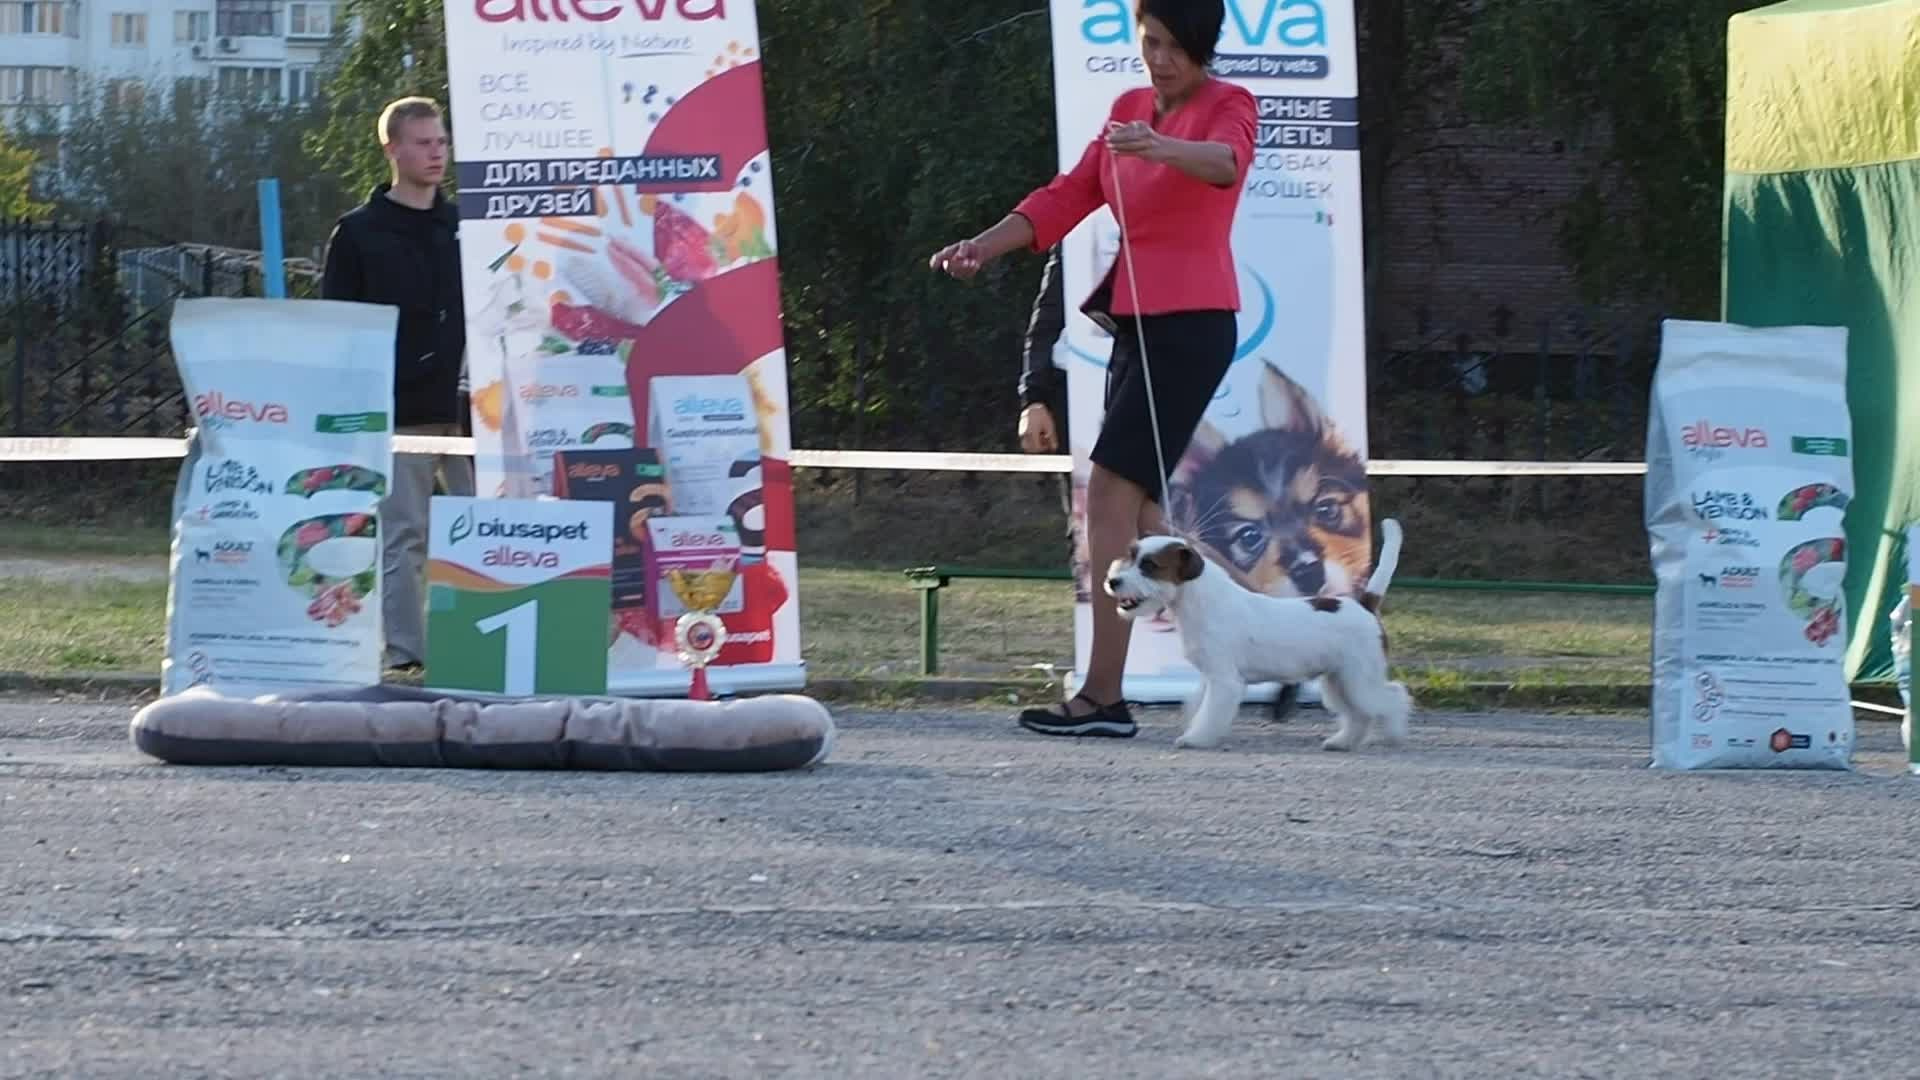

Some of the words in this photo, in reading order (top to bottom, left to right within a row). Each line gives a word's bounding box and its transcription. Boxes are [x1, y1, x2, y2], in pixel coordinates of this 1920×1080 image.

[502, 31, 583, 54] Inspired
[588, 32, 617, 56] by
[621, 33, 693, 50] Nature
[1086, 55, 1145, 73] care
[1213, 56, 1259, 75] igned
[1261, 57, 1281, 76] by
[1283, 58, 1319, 73] vets
[480, 72, 529, 94] ВСЕ
[480, 101, 576, 122] САМОЕ
[1257, 98, 1333, 119] РНЫЕ
[481, 129, 595, 151] ЛУЧШЕЕ
[483, 161, 541, 187] ДЛЯ
[549, 156, 719, 185] ПРЕДАННЫХ
[486, 189, 593, 219] ДРУЗЕЙ
[193, 391, 289, 424] alleva
[673, 394, 745, 415] alleva
[1681, 419, 1769, 448] alleva
[478, 519, 589, 544] Diusapet
[482, 547, 560, 569] alleva
[475, 599, 538, 696] 1
